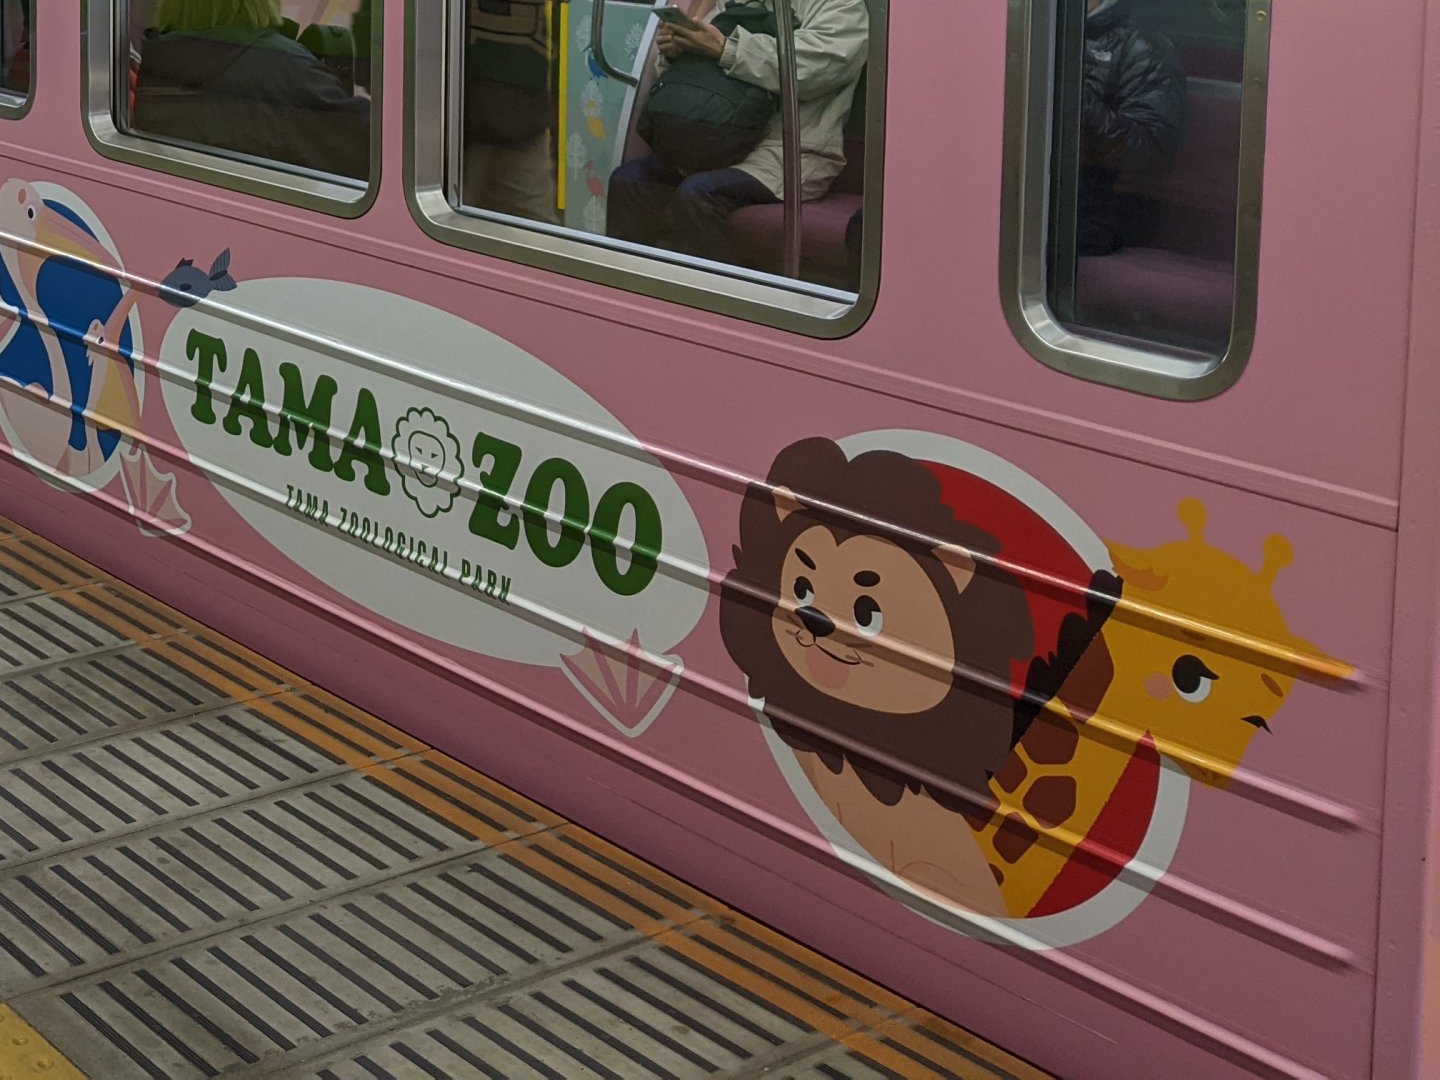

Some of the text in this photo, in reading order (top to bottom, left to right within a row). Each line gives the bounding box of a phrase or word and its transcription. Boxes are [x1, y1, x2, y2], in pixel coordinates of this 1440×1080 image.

[186, 328, 662, 596] TAMA ZOO
[286, 484, 511, 605] TAMA ZOOLOGICAL PARK
